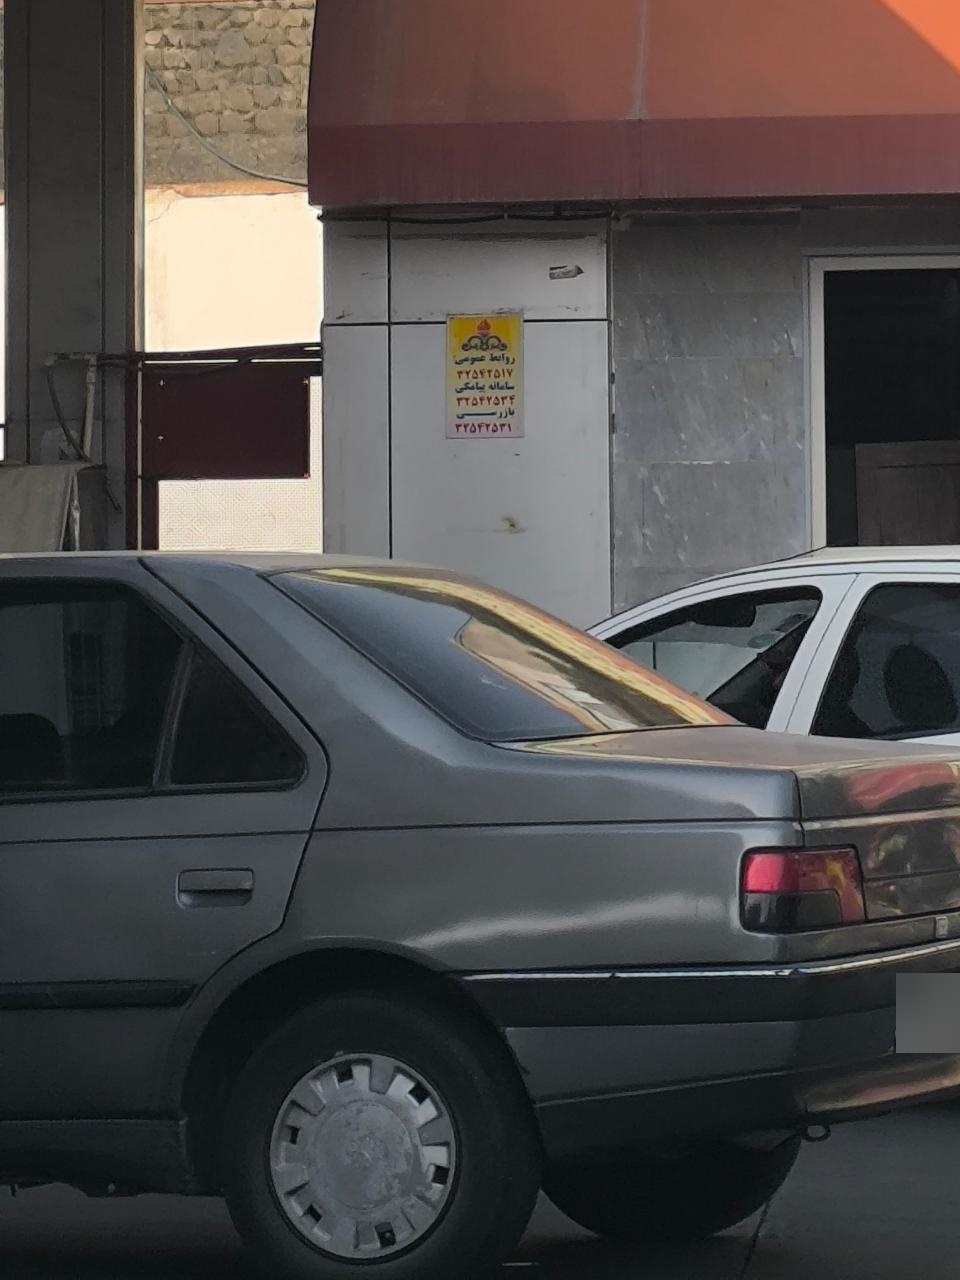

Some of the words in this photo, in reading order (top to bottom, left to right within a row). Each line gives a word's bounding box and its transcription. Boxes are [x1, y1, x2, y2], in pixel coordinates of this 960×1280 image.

[455, 355, 486, 365] عمومی
[489, 353, 516, 365] روابط
[455, 381, 486, 393] پیامکی
[489, 381, 515, 391] سامانه
[456, 407, 515, 419] بازرسی
